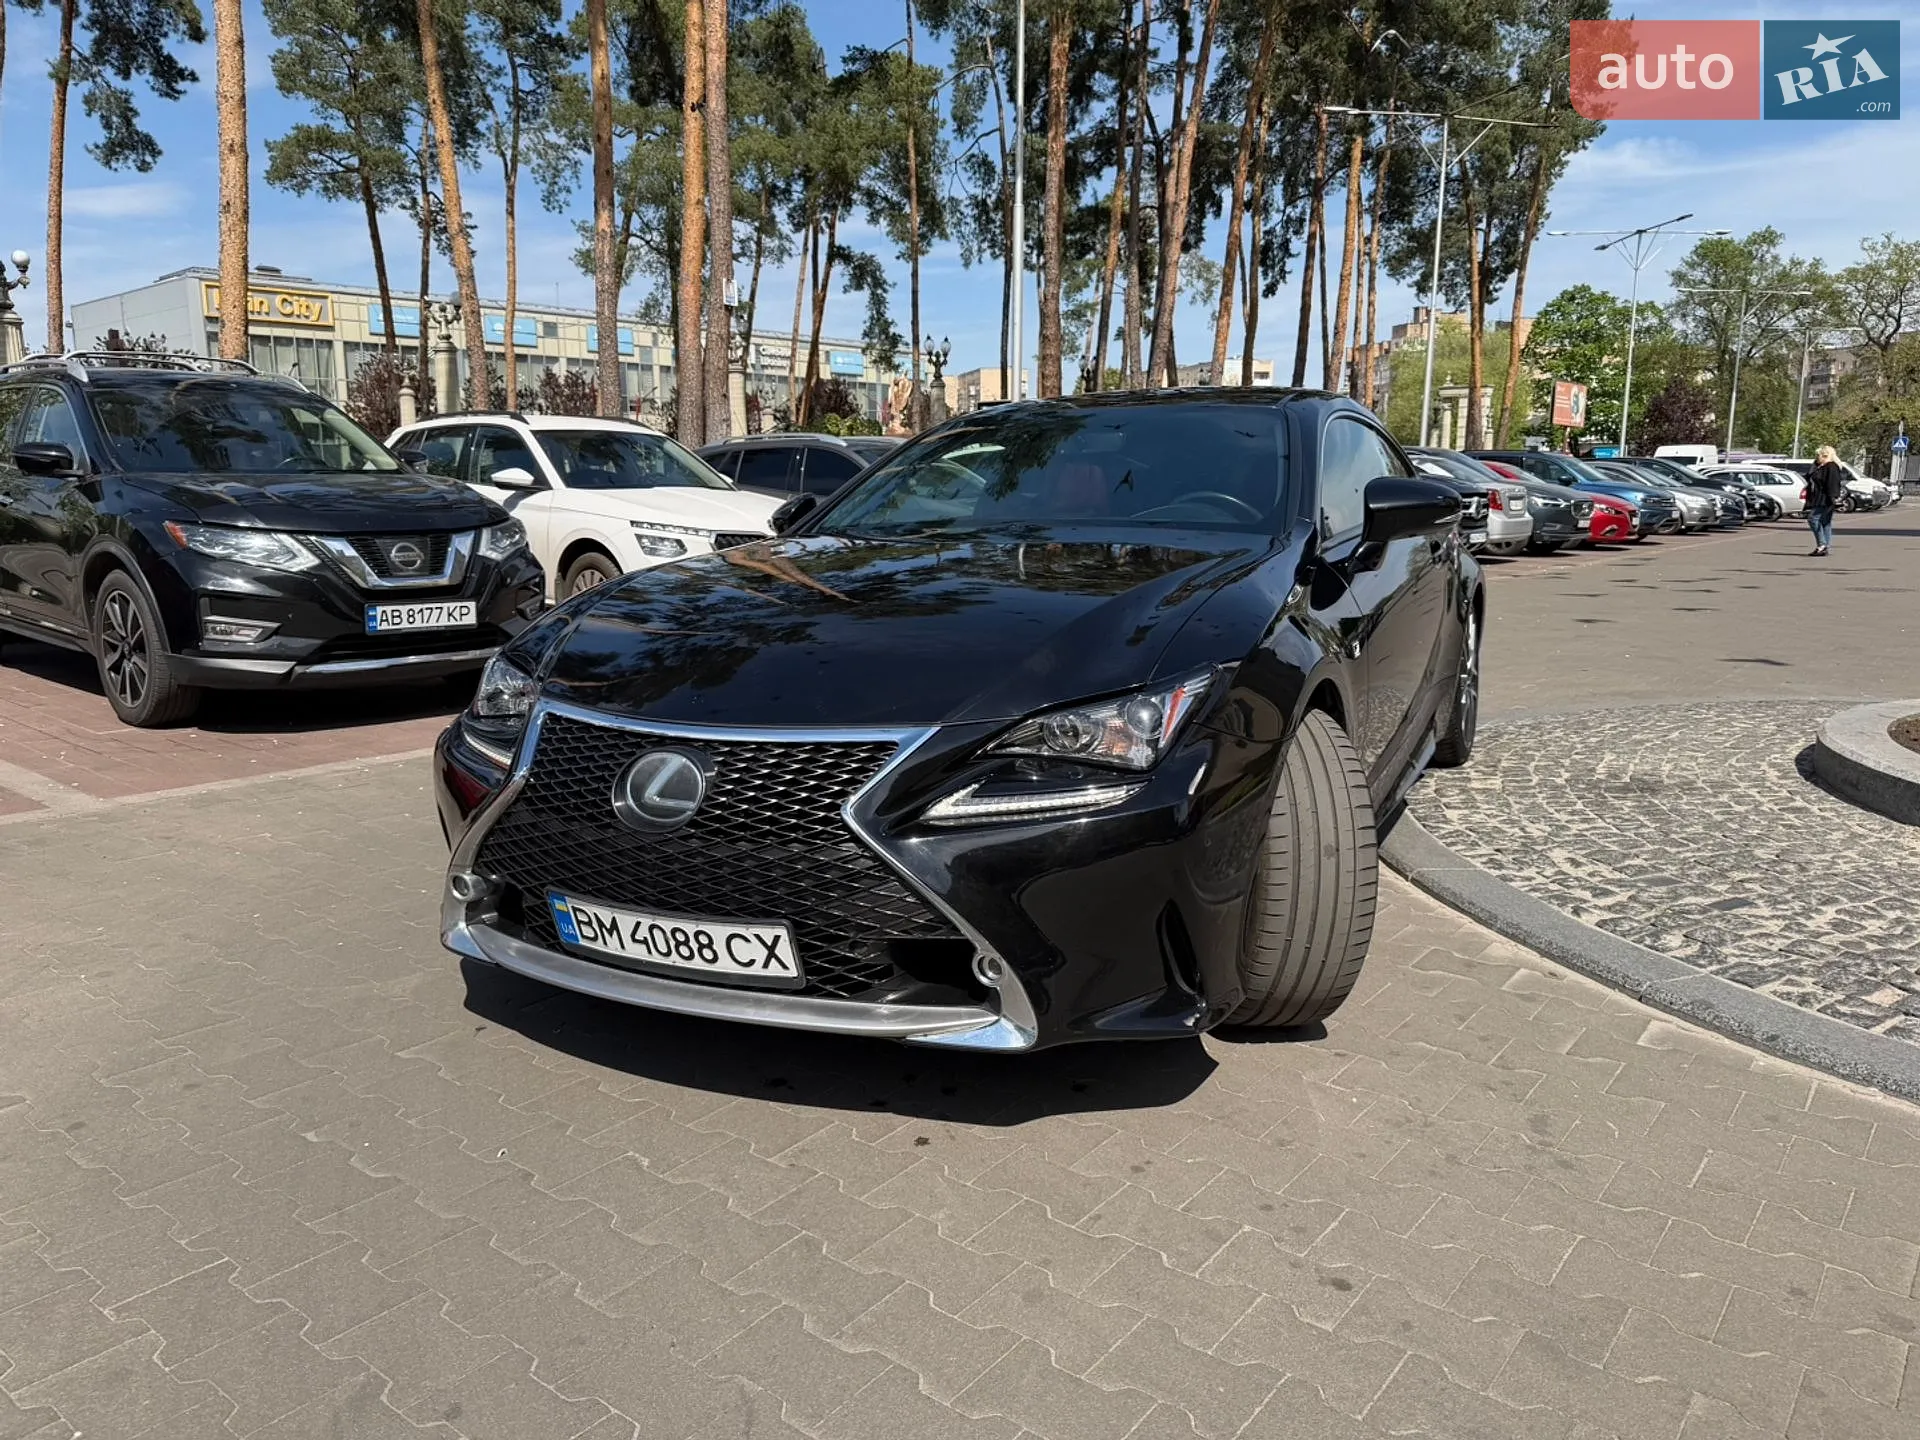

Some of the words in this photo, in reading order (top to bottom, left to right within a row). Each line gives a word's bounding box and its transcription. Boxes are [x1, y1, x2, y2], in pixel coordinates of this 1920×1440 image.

[276, 293, 322, 322] City
[379, 609, 402, 627] AB
[406, 607, 443, 625] 8177
[447, 605, 471, 623] KP
[571, 905, 626, 950] BM
[630, 921, 719, 964] 4088
[725, 933, 790, 971] CX
